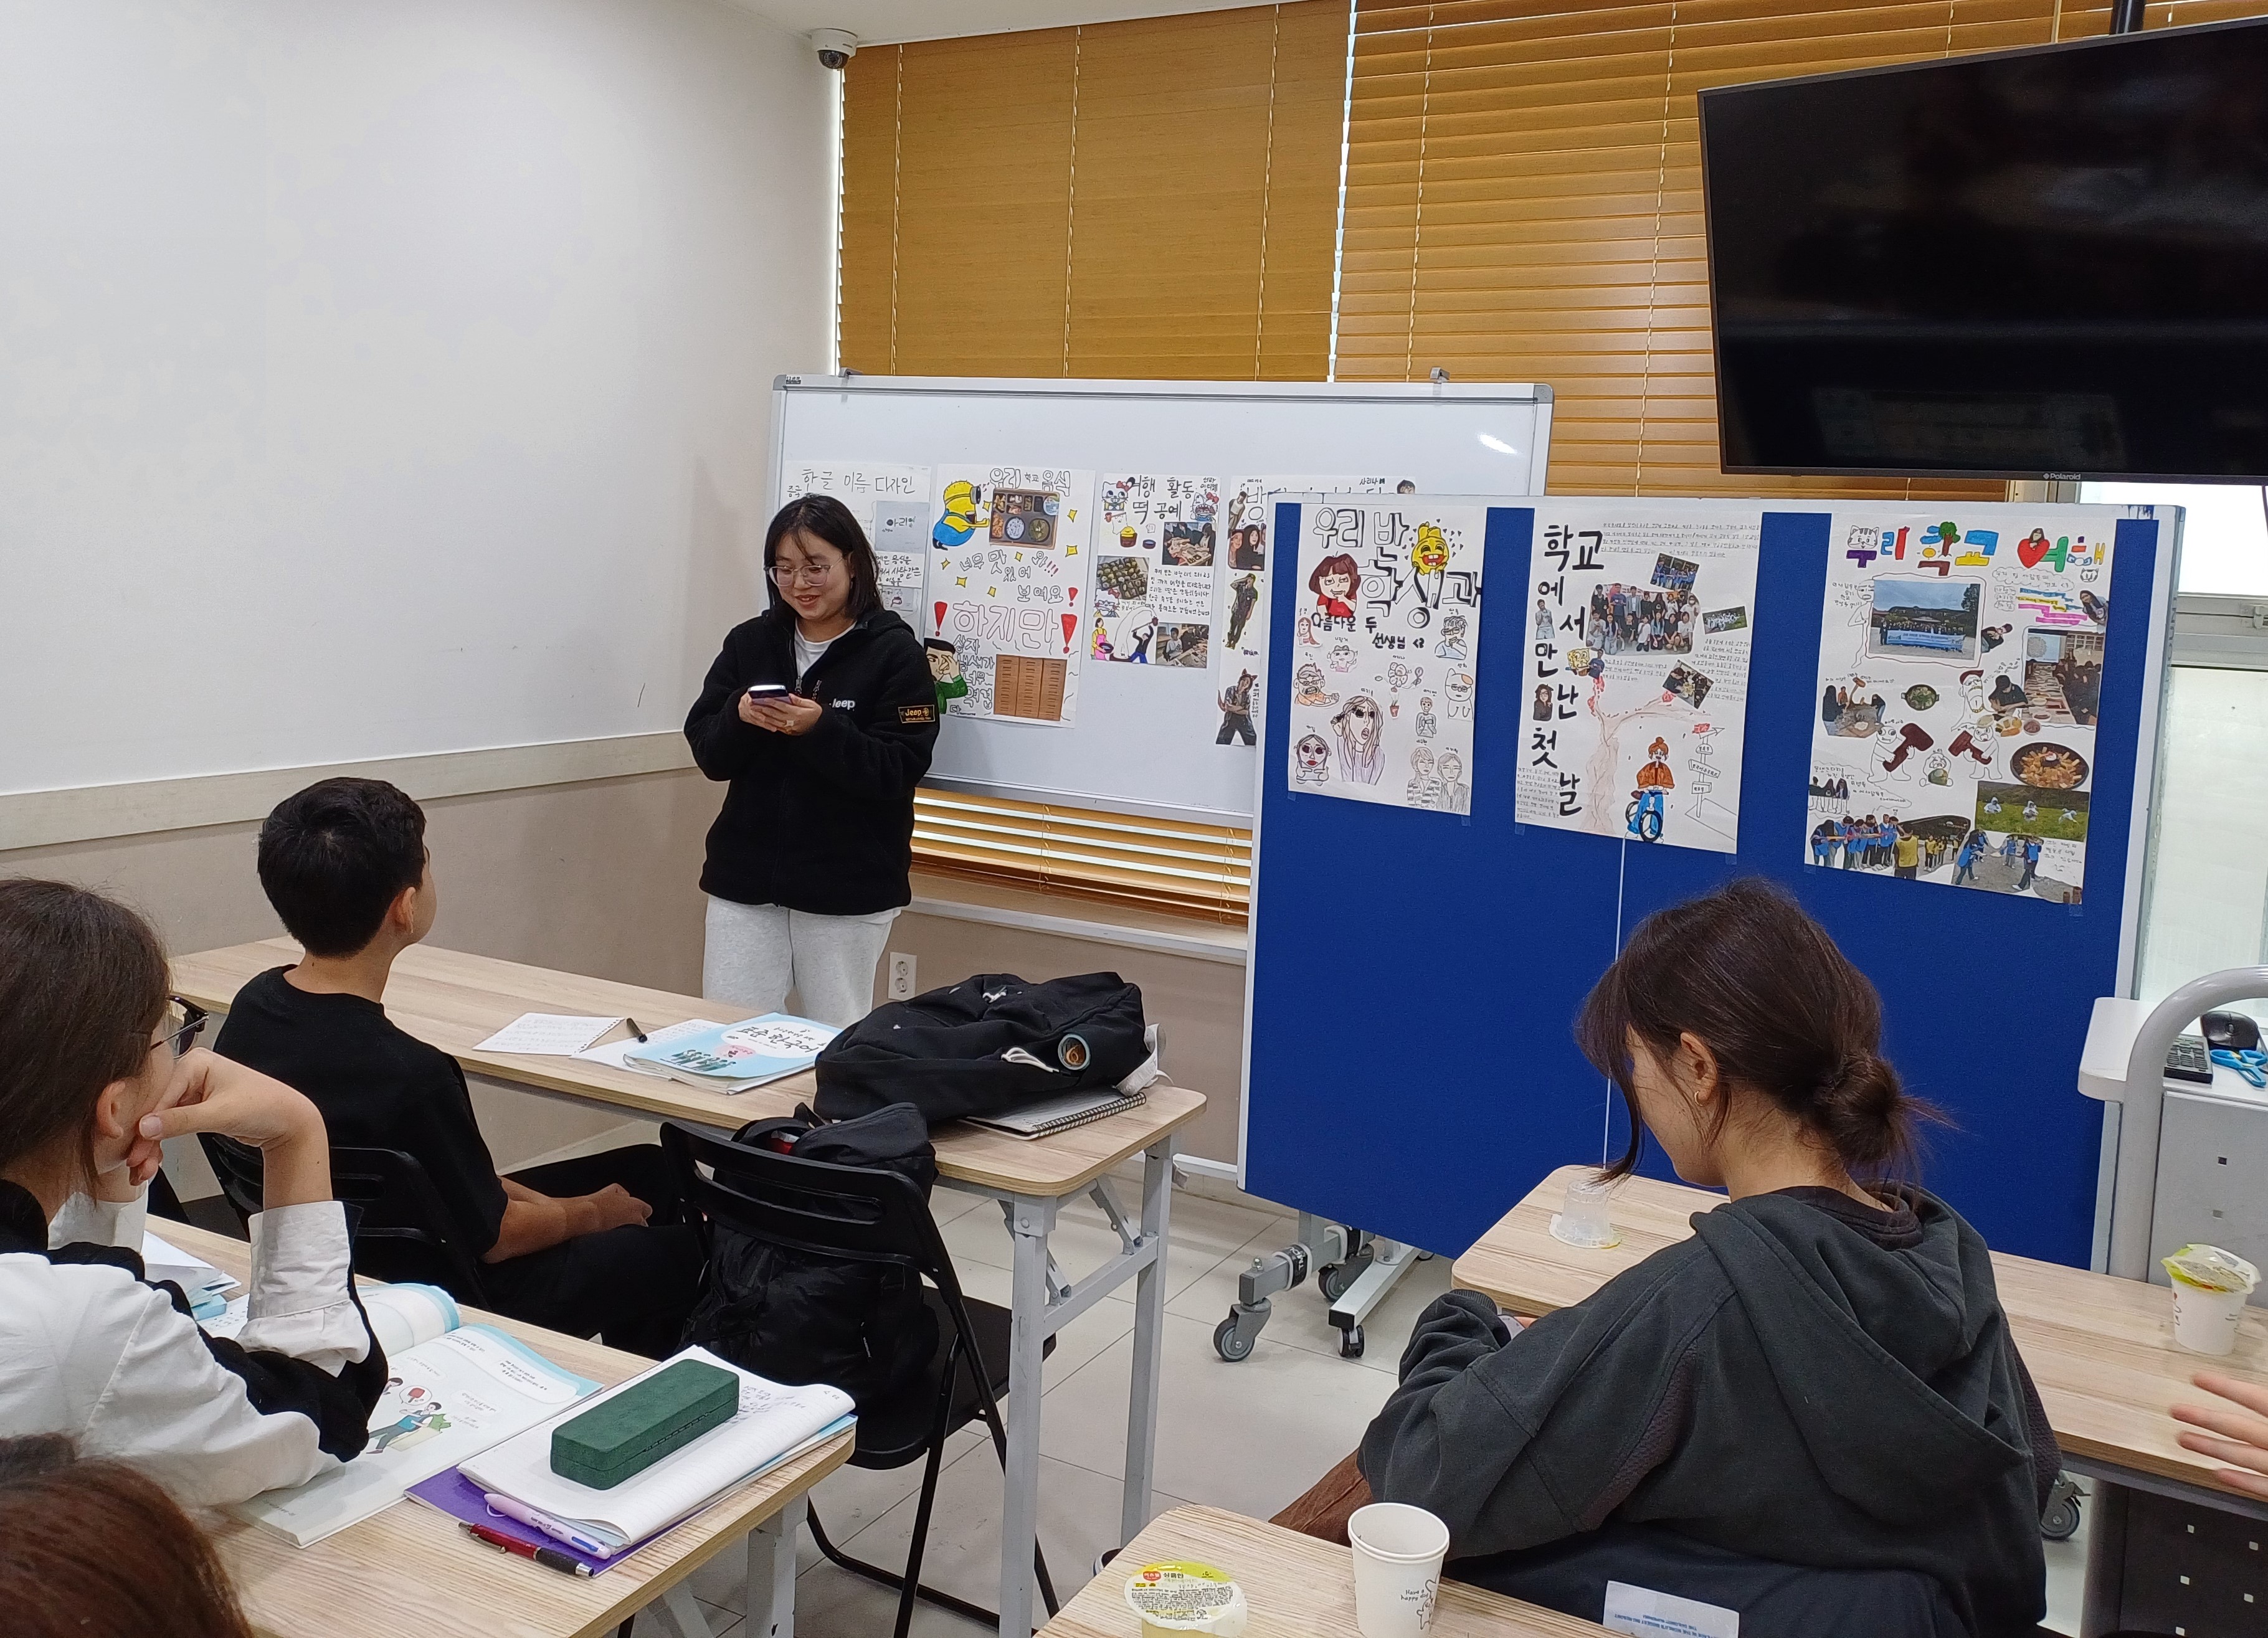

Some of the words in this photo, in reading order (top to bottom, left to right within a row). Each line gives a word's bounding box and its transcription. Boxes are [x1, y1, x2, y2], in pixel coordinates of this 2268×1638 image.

[802, 468, 833, 493] 한글
[844, 471, 871, 493] 이름
[875, 475, 916, 495] 디자인
[989, 467, 1022, 489] 우리
[1023, 472, 1039, 483] 학교
[1041, 470, 1071, 497] 음식
[1167, 476, 1194, 499] 활동
[1132, 500, 1149, 524] 떡
[1153, 500, 1182, 521] 공예
[1312, 507, 1365, 549] 우리
[1917, 521, 2000, 576] 학교
[959, 552, 985, 572] 너무
[1311, 612, 1357, 632] 아름다운
[1365, 617, 1377, 634] 두
[952, 634, 980, 655] 상자
[1372, 632, 1406, 650] 선생님
[962, 670, 985, 686] 너무
[904, 709, 922, 717] Jeep
[768, 1033, 819, 1053] 한국어
[1400, 1594, 1418, 1602] happy
